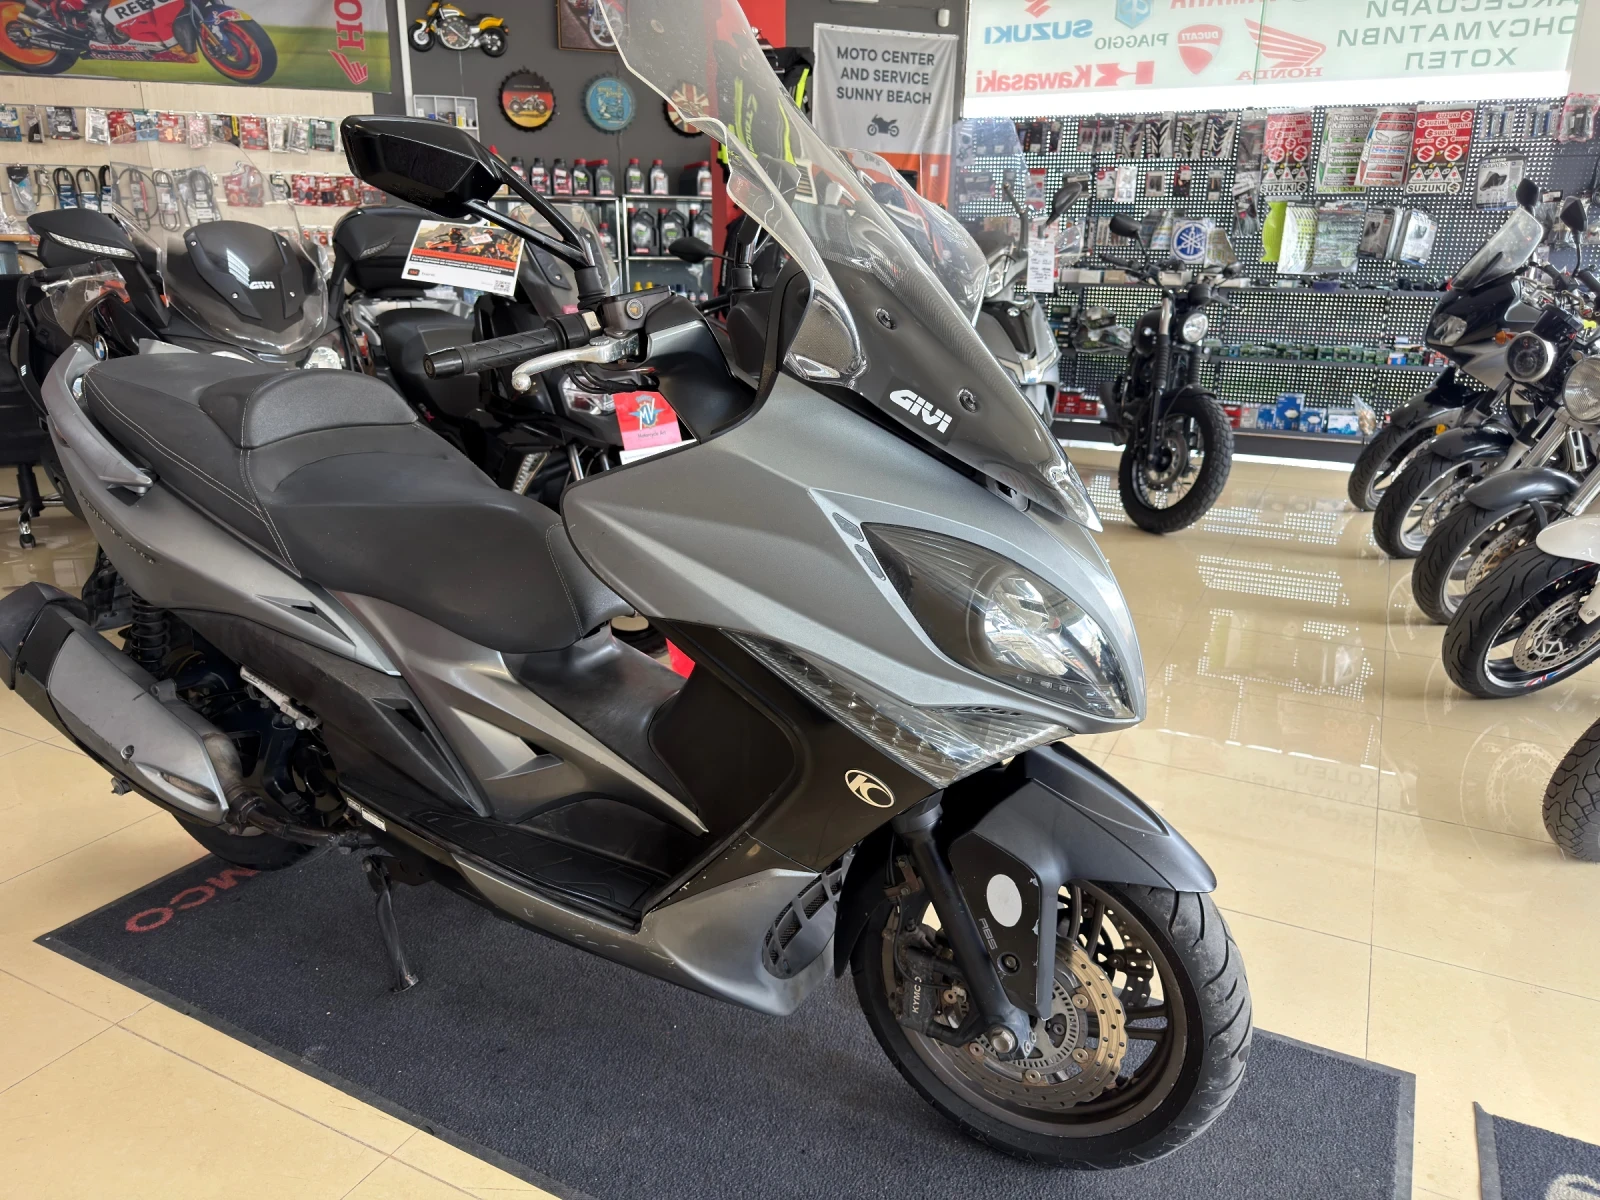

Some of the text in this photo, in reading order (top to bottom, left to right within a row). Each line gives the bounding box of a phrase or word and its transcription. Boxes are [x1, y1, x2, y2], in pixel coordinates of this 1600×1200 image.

[837, 46, 935, 66] MOTO CENTER
[840, 67, 929, 85] AND SERVICE
[836, 86, 932, 105] SUNNY BEACH
[1261, 184, 1296, 193] SUZUKI
[1407, 183, 1447, 193] SUZUKI
[249, 281, 275, 290] GIVI
[889, 389, 953, 434] GIVI
[979, 917, 998, 950] ABS
